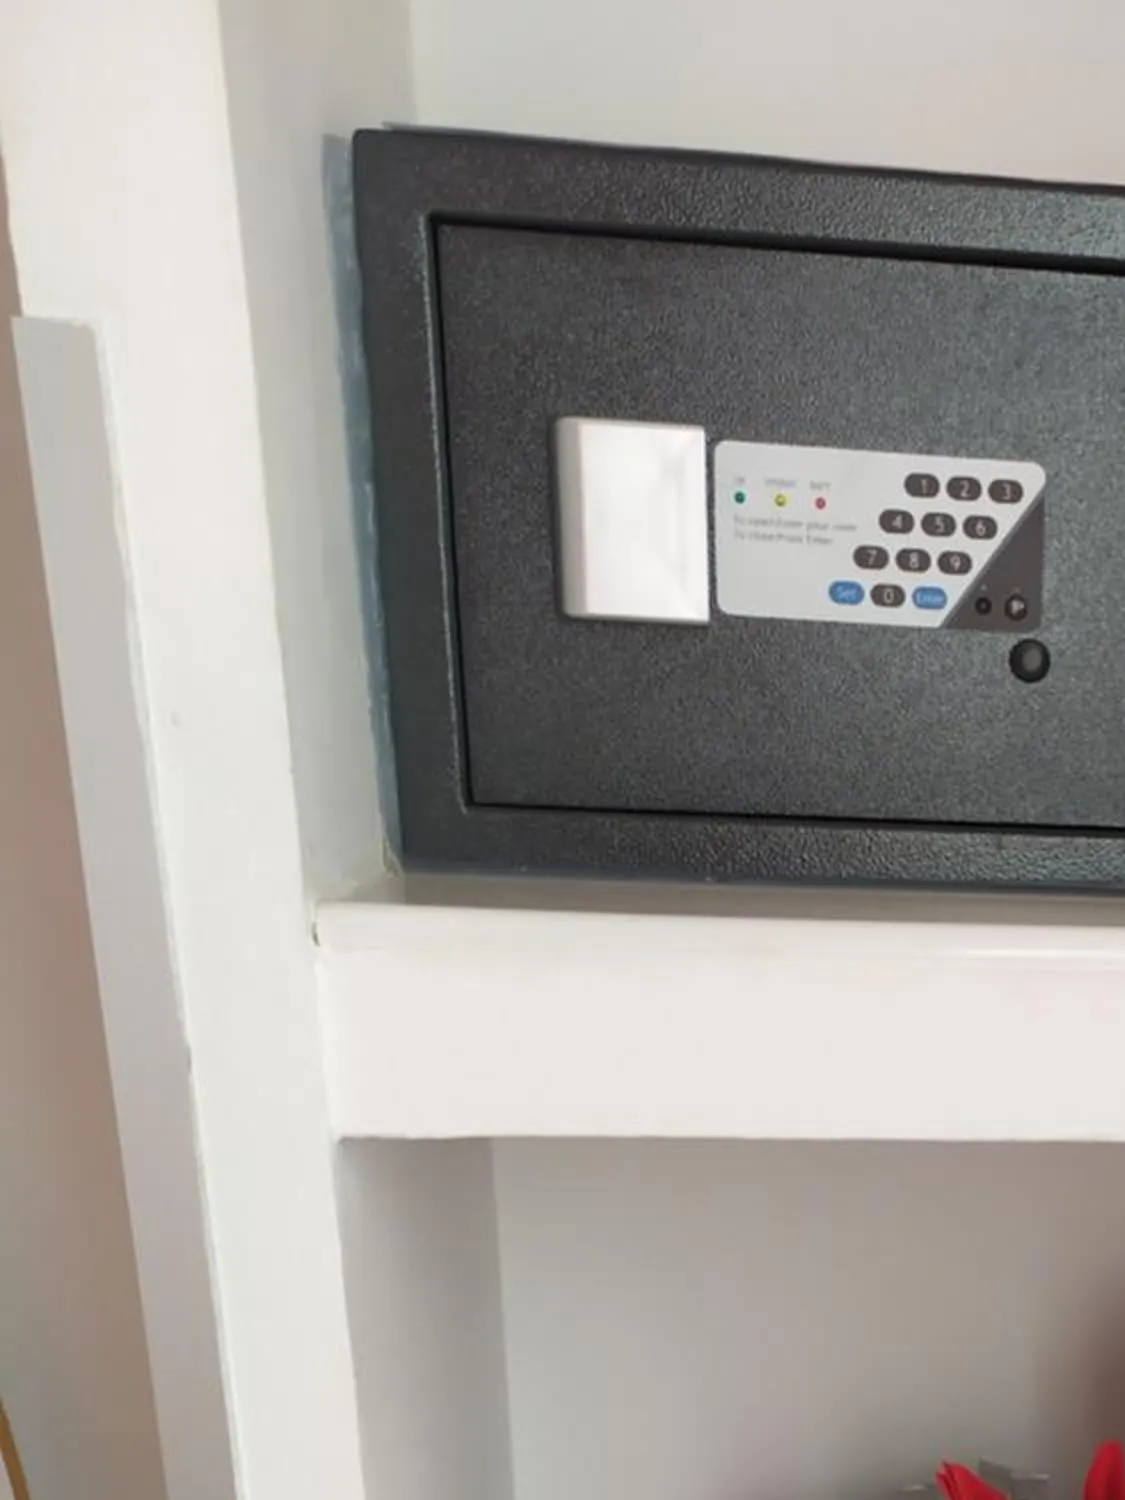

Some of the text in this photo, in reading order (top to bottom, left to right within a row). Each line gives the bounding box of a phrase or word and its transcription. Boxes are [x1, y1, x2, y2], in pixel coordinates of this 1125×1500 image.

[975, 520, 985, 536] 6
[836, 585, 944, 604] Set 0 Enter
